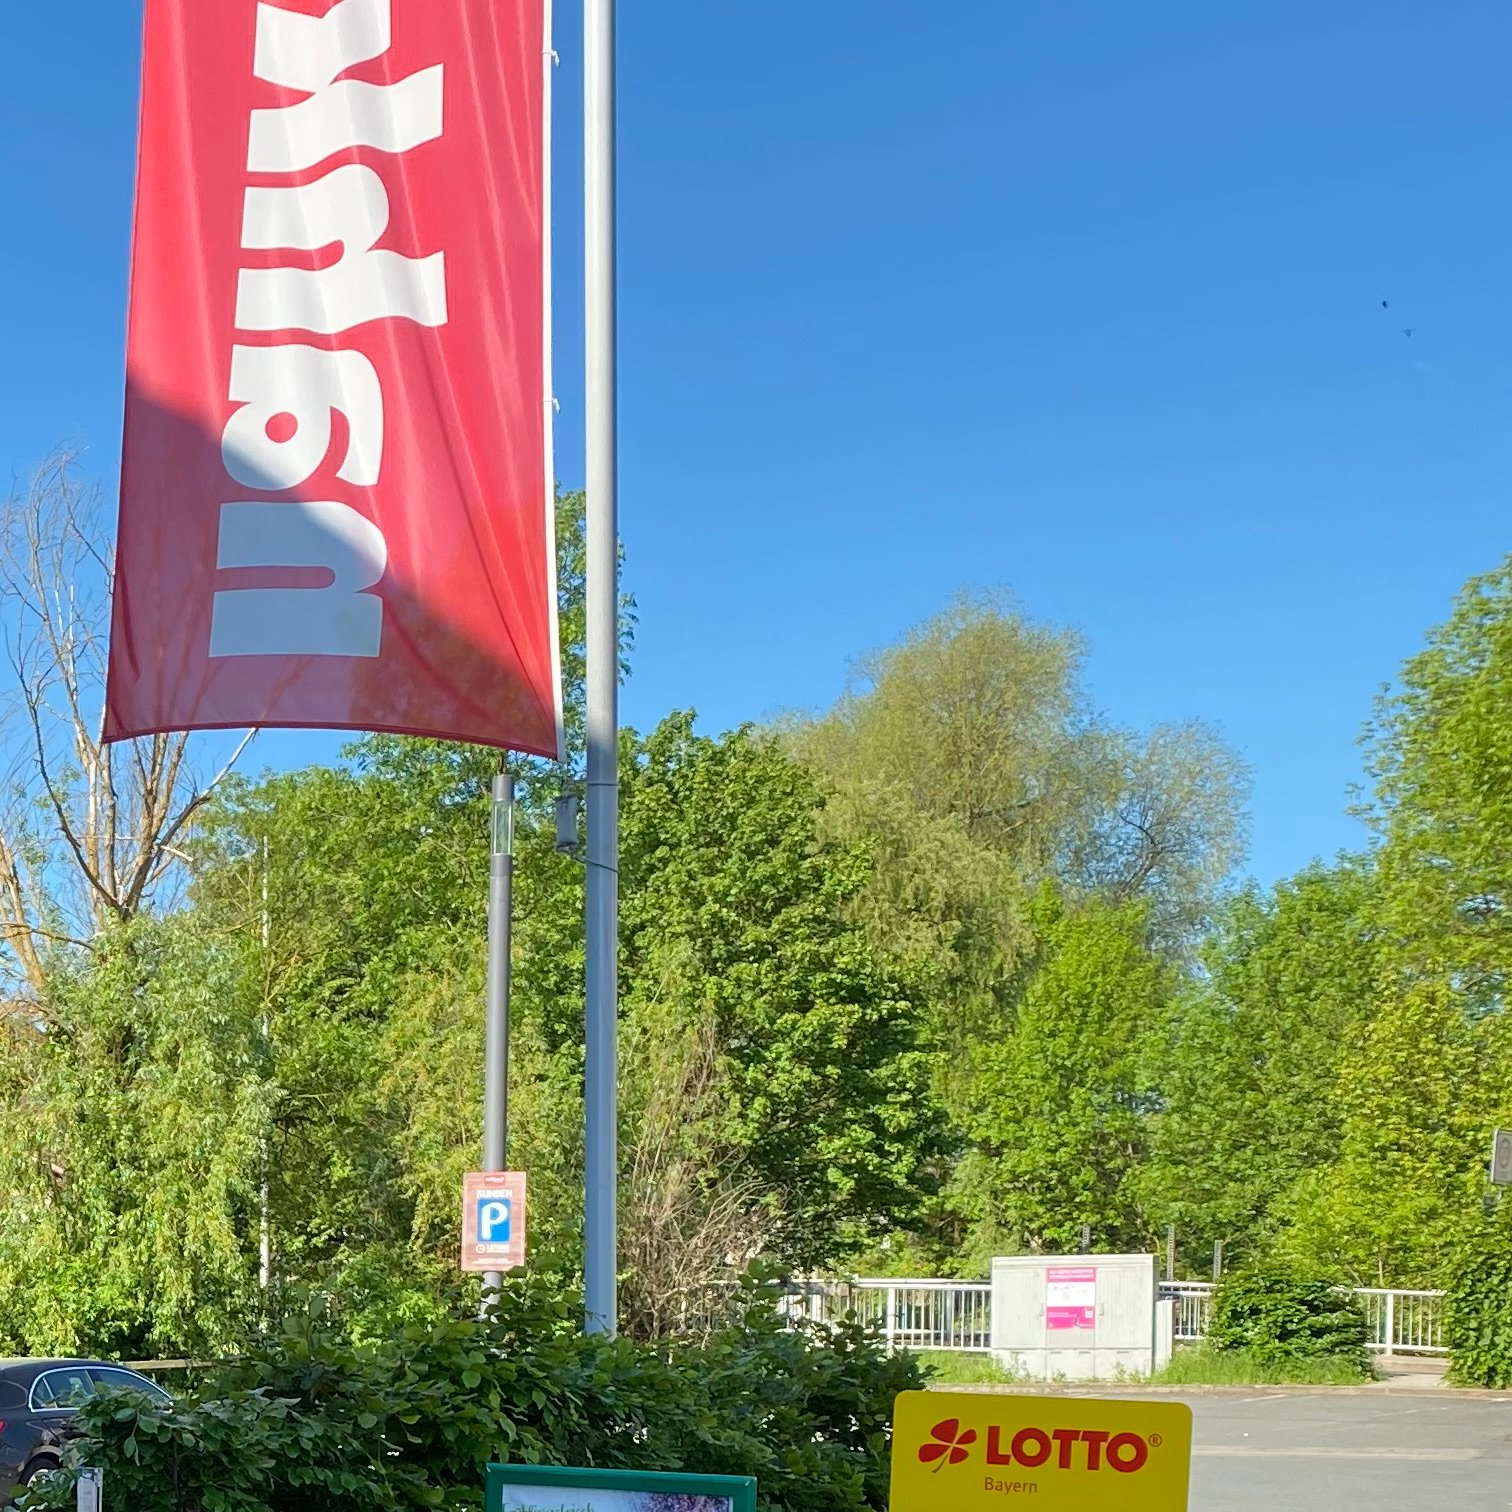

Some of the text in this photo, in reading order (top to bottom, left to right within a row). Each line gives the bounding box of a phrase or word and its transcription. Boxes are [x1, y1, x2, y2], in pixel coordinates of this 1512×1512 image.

[481, 1202, 508, 1240] P
[986, 1425, 1149, 1473] LOTTO
[984, 1477, 1038, 1495] Bayern
